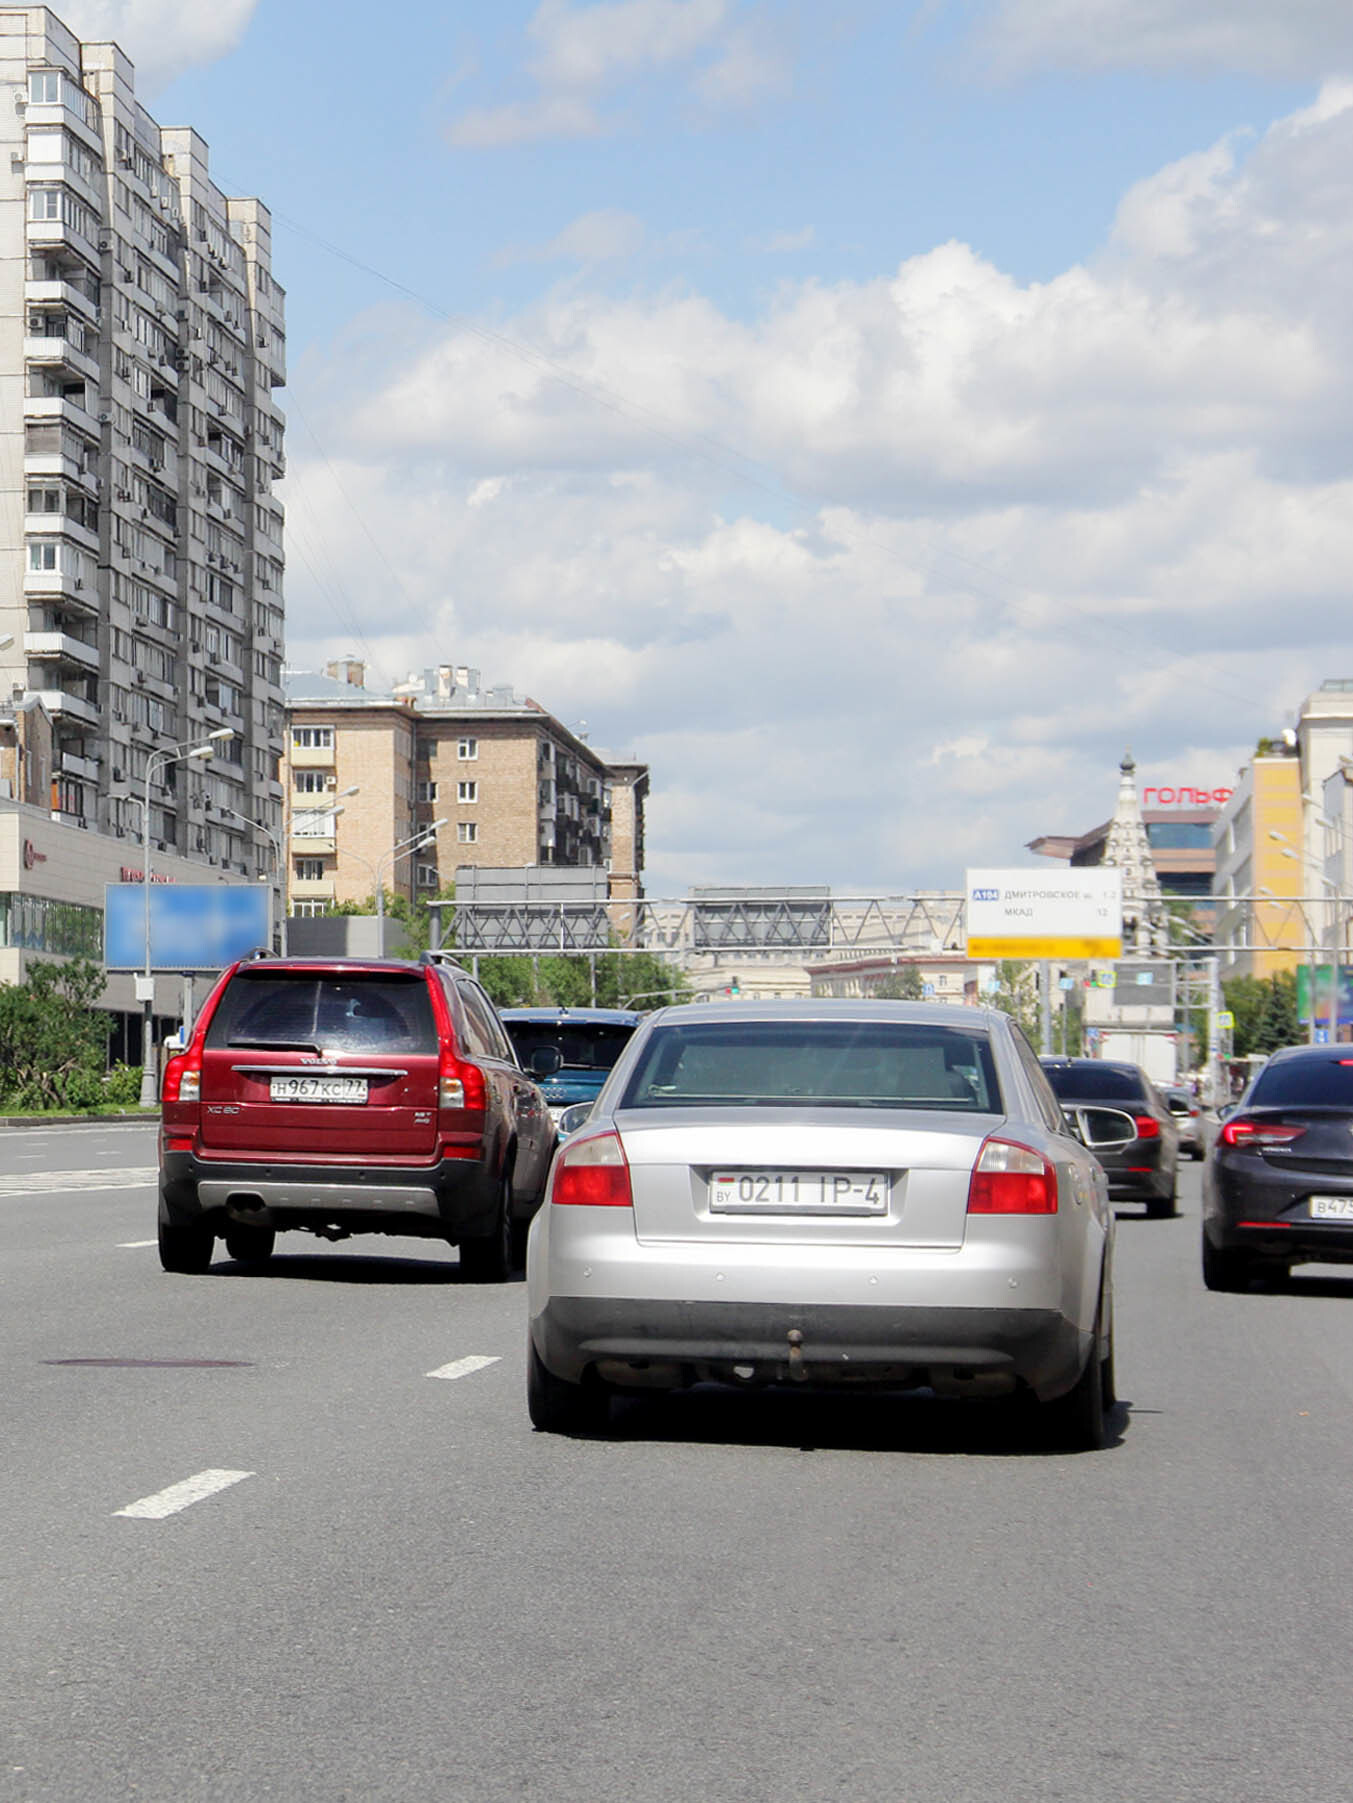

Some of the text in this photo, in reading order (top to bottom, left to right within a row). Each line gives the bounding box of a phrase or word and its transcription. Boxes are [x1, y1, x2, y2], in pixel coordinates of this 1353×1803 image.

[1143, 787, 1234, 804] ГОЛЬФ
[1004, 908, 1033, 917] МКАД
[276, 1080, 342, 1097] Н967КС
[716, 1192, 731, 1203] BY
[739, 1176, 880, 1205] 0211 IP-4
